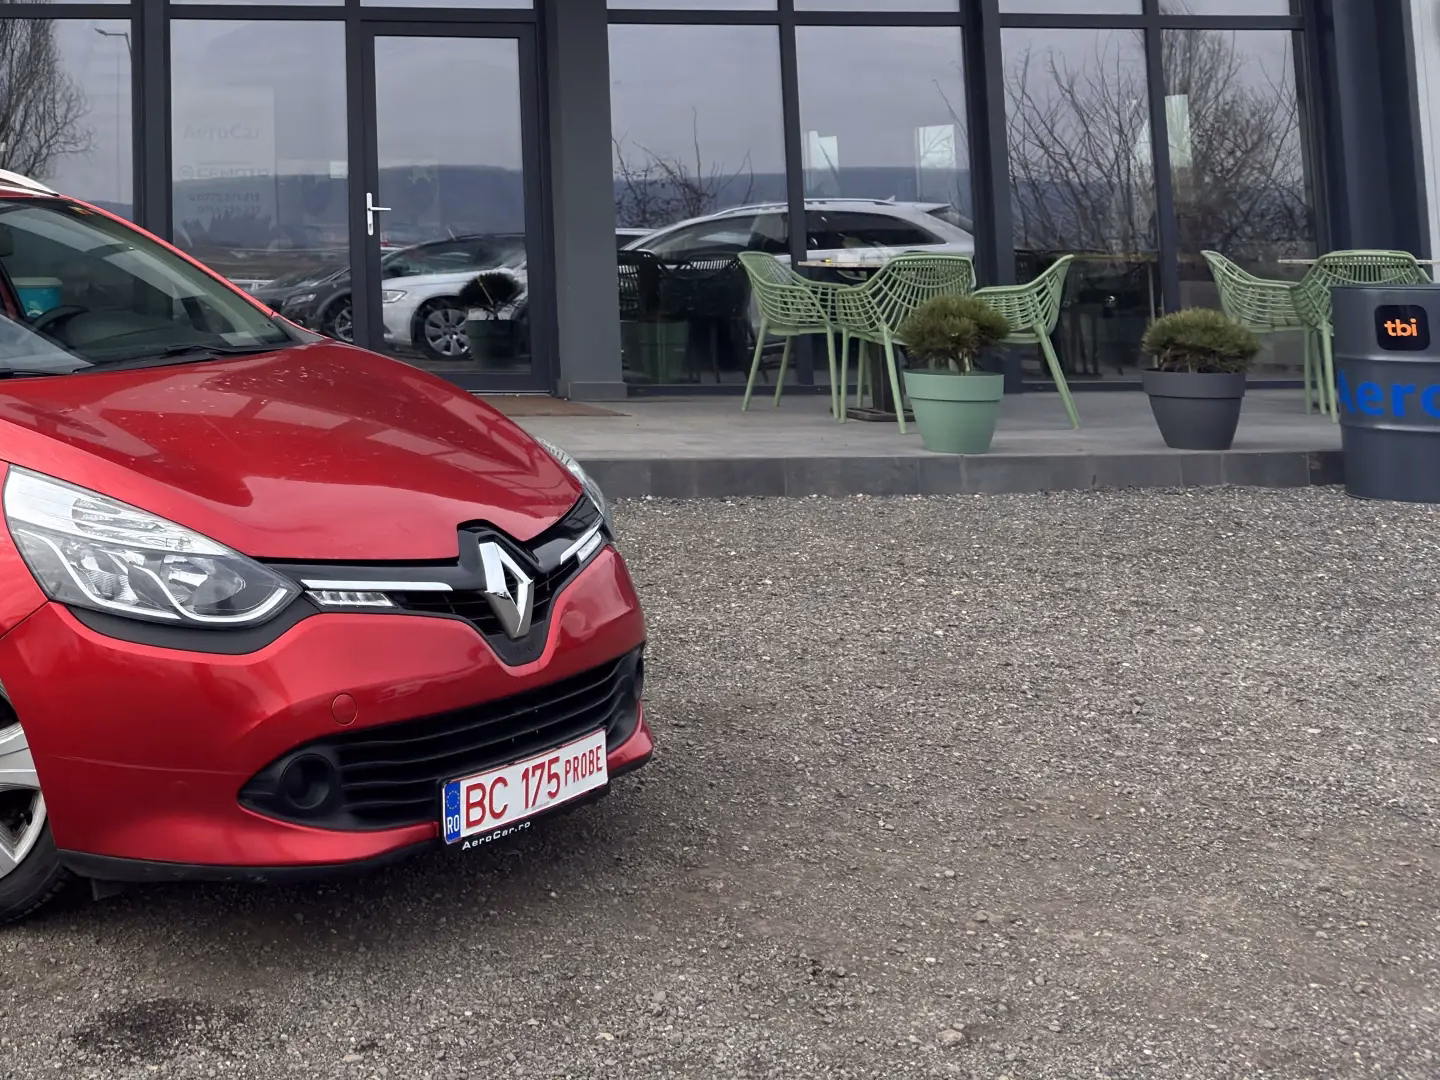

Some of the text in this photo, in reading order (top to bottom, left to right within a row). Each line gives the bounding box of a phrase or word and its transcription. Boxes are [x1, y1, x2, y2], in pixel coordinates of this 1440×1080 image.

[1383, 318, 1418, 337] tbi
[465, 744, 603, 829] BC 175 PROBE
[446, 814, 460, 834] RO
[461, 821, 531, 850] AeroCar.ro
